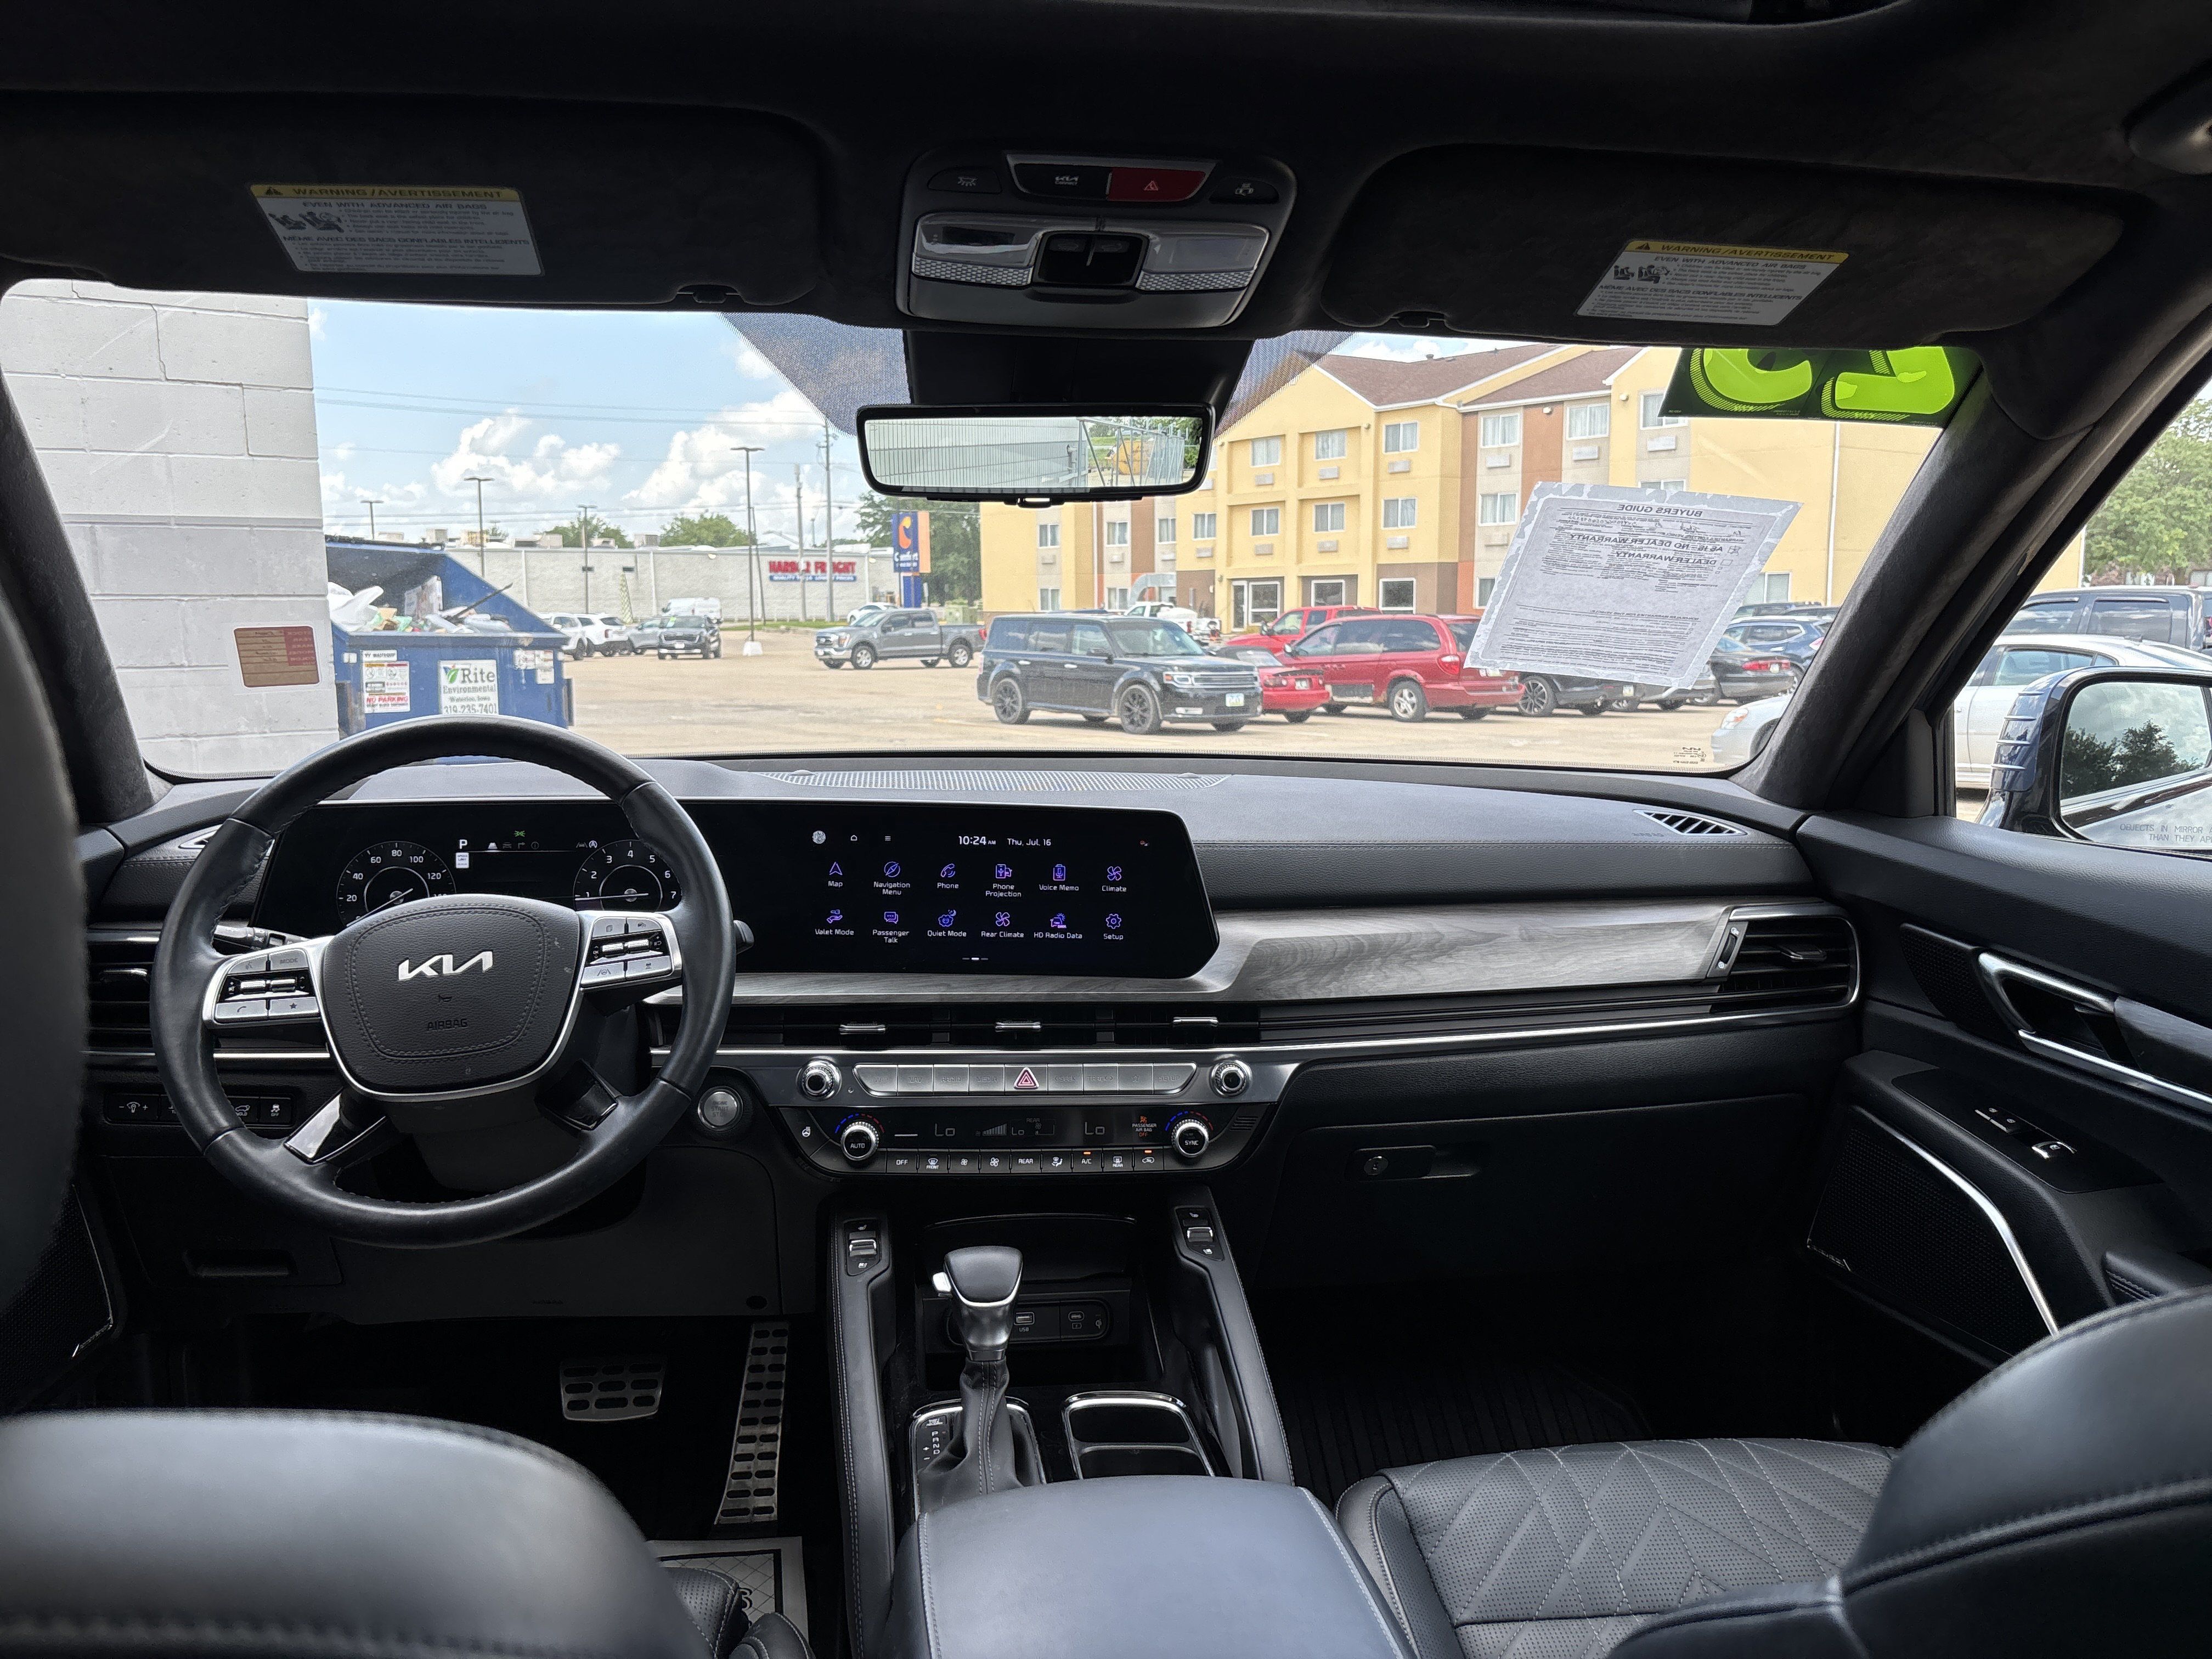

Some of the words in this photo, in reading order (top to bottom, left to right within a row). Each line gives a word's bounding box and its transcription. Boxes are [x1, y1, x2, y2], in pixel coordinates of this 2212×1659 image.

[1708, 258, 1759, 267] ADVANCED
[815, 561, 856, 574] FRIGHT
[461, 667, 495, 684] Rite
[443, 684, 496, 694] Environmental
[2120, 823, 2154, 832] OBJECTS
[958, 836, 986, 845] 10:24
[2174, 834, 2195, 843] THEY
[459, 839, 467, 849] P
[627, 850, 634, 858] 4
[606, 855, 612, 864] 3
[649, 855, 656, 863] 5
[591, 871, 597, 879] 2
[665, 870, 671, 878] 6
[873, 881, 911, 890] Navigation
[670, 891, 677, 899] 7
[985, 890, 1022, 899] Projection
[872, 929, 910, 938] Passenger
[927, 930, 945, 938] Quiet
[426, 1019, 468, 1031] AIRBAG
[934, 1123, 956, 1137] Lo
[1084, 1122, 1105, 1136] Lo
